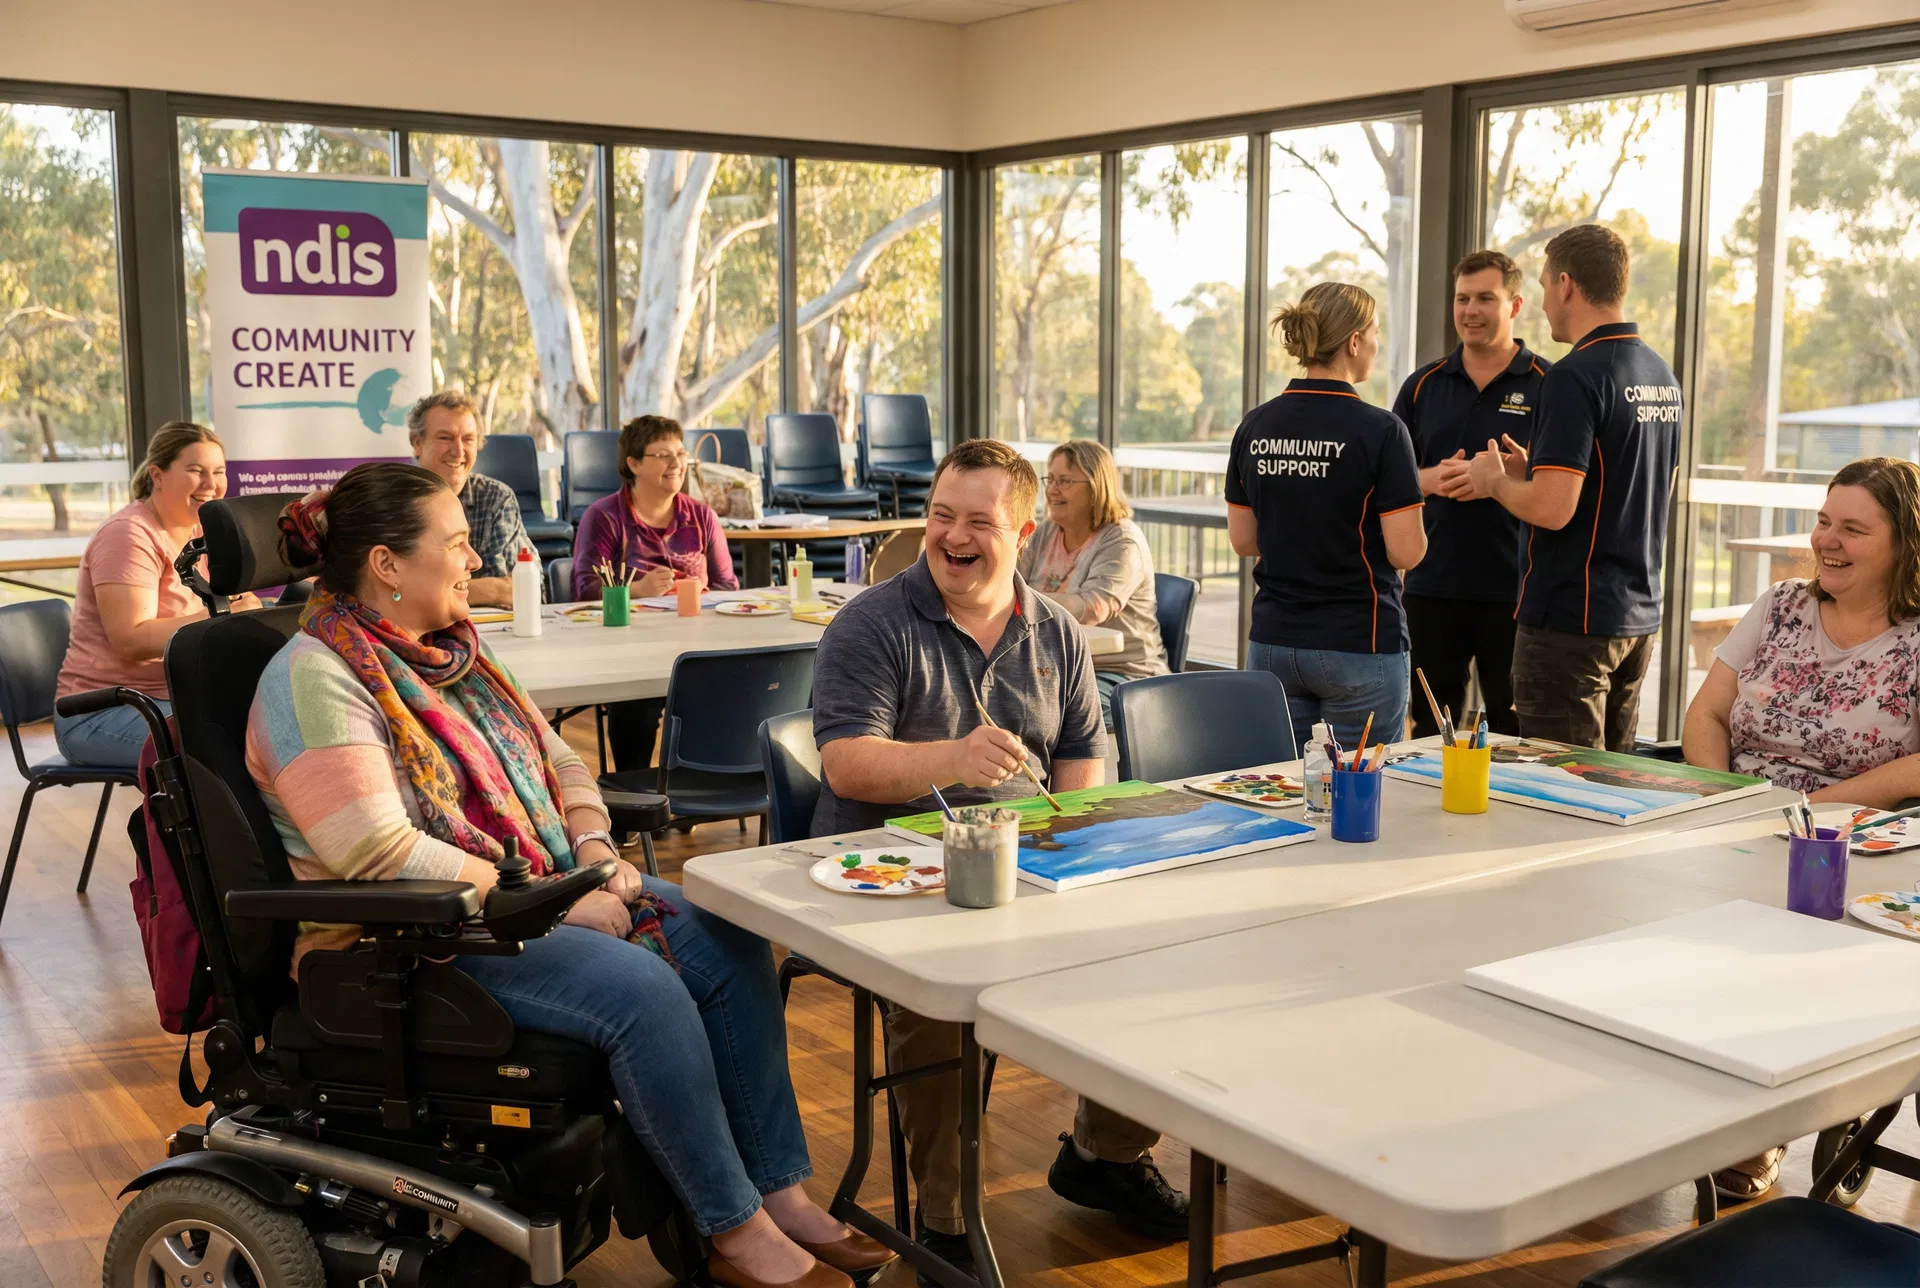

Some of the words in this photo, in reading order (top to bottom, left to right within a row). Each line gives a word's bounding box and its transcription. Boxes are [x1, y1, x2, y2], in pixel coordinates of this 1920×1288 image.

[253, 223, 385, 286] ndis
[231, 327, 416, 352] COMMUNITY
[233, 361, 356, 388] CREATE
[1636, 405, 1680, 422] SUPPORT
[1249, 438, 1346, 458] COMMUNITY
[1257, 458, 1331, 478] SUPPORT
